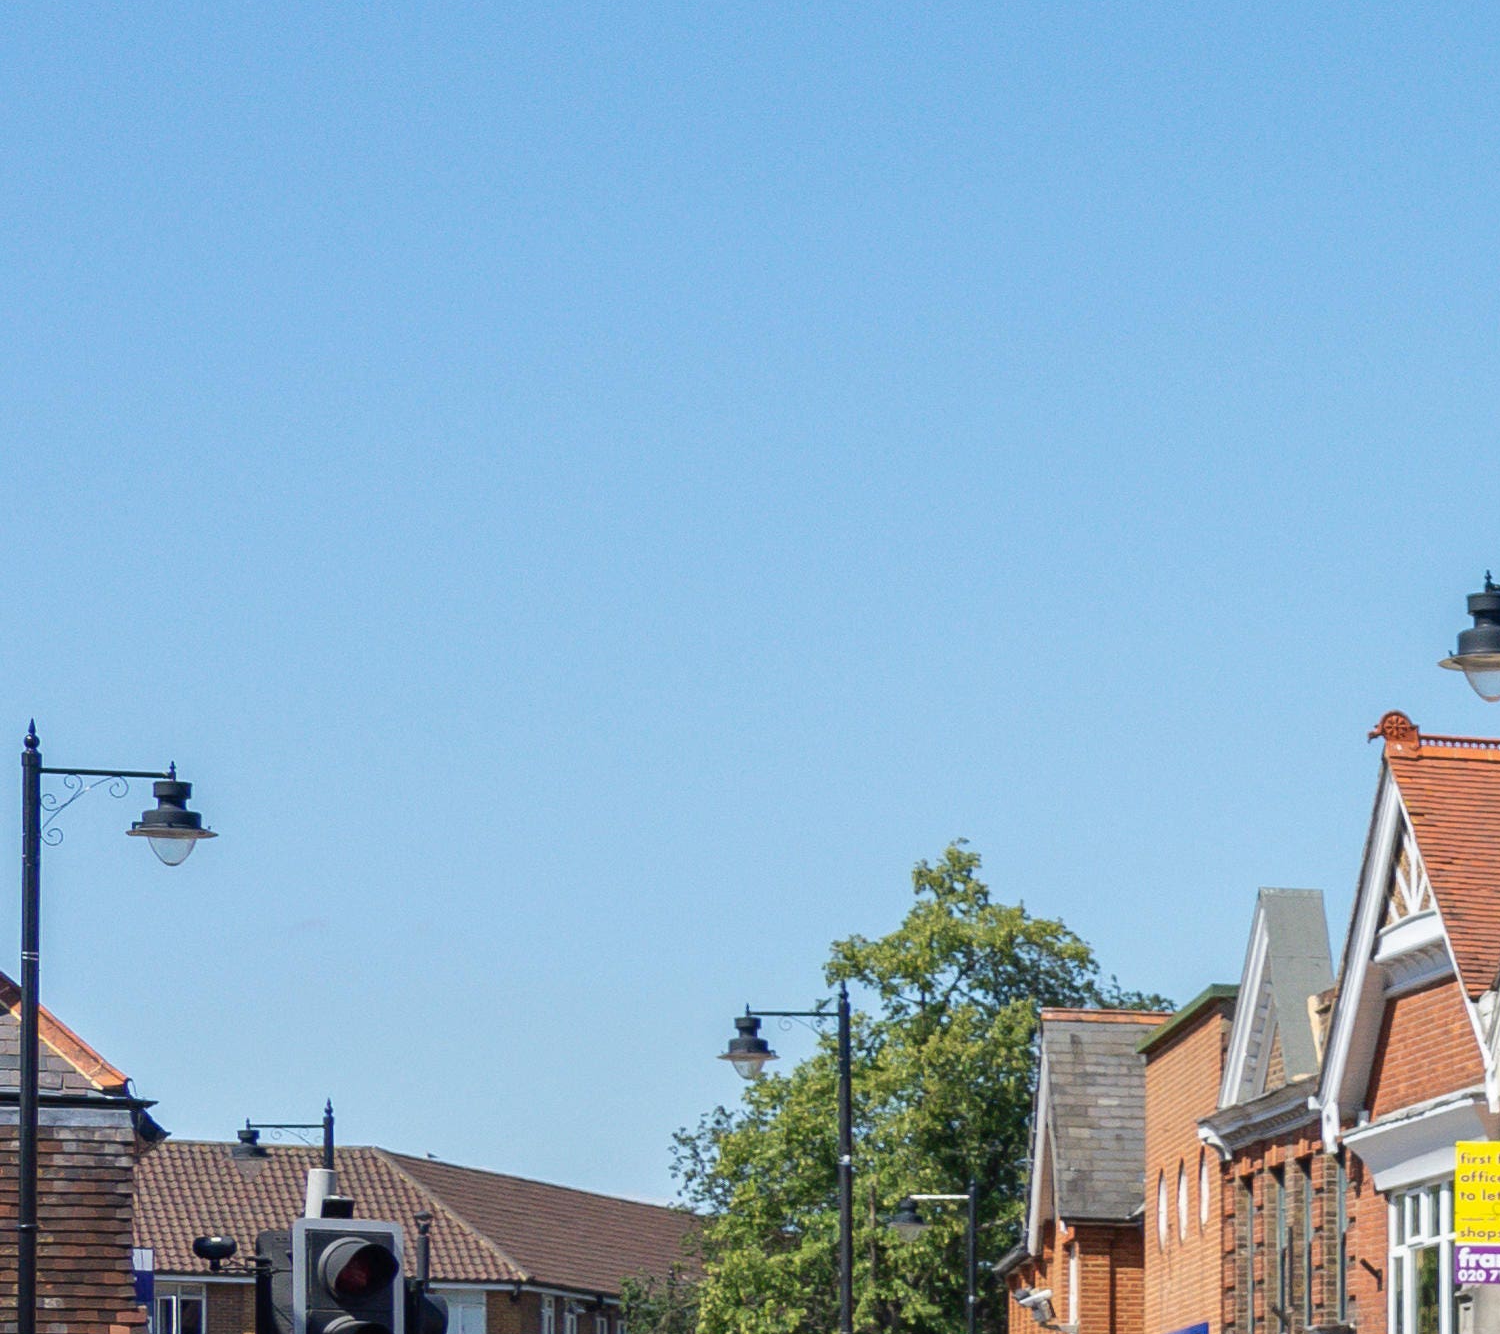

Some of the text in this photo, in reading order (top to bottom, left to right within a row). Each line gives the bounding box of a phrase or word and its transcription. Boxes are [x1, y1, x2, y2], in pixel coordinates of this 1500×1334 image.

[1460, 1152, 1492, 1165] first
[1459, 1190, 1476, 1202] to
[1457, 1269, 1488, 1282] 020
